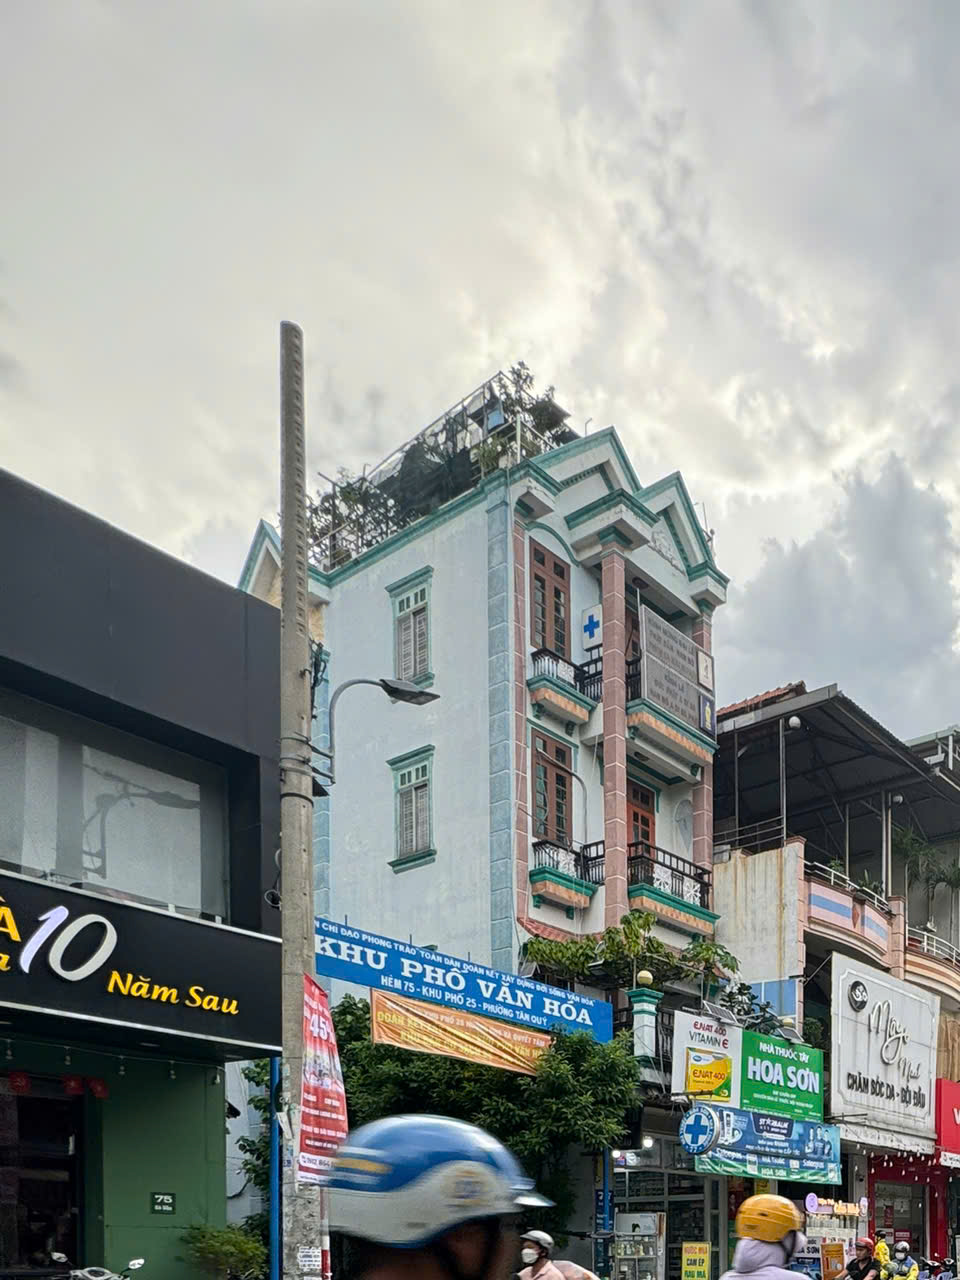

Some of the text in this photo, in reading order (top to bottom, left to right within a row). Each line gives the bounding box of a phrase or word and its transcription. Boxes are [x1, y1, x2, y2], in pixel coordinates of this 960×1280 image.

[19, 905, 118, 981] 10
[361, 934, 392, 949] PHONG
[107, 970, 240, 1015] Năm Sau
[315, 934, 388, 970] KHU
[477, 978, 534, 1010] VĂN
[543, 997, 594, 1026] HÓA
[404, 981, 415, 992] 75
[422, 986, 442, 999] KHU
[466, 997, 477, 1008] 25
[689, 1031, 720, 1047] VITAMIN
[759, 1042, 775, 1054] NHÀ
[747, 1056, 820, 1095] HOA SƠN
[154, 1194, 173, 1203] 75
